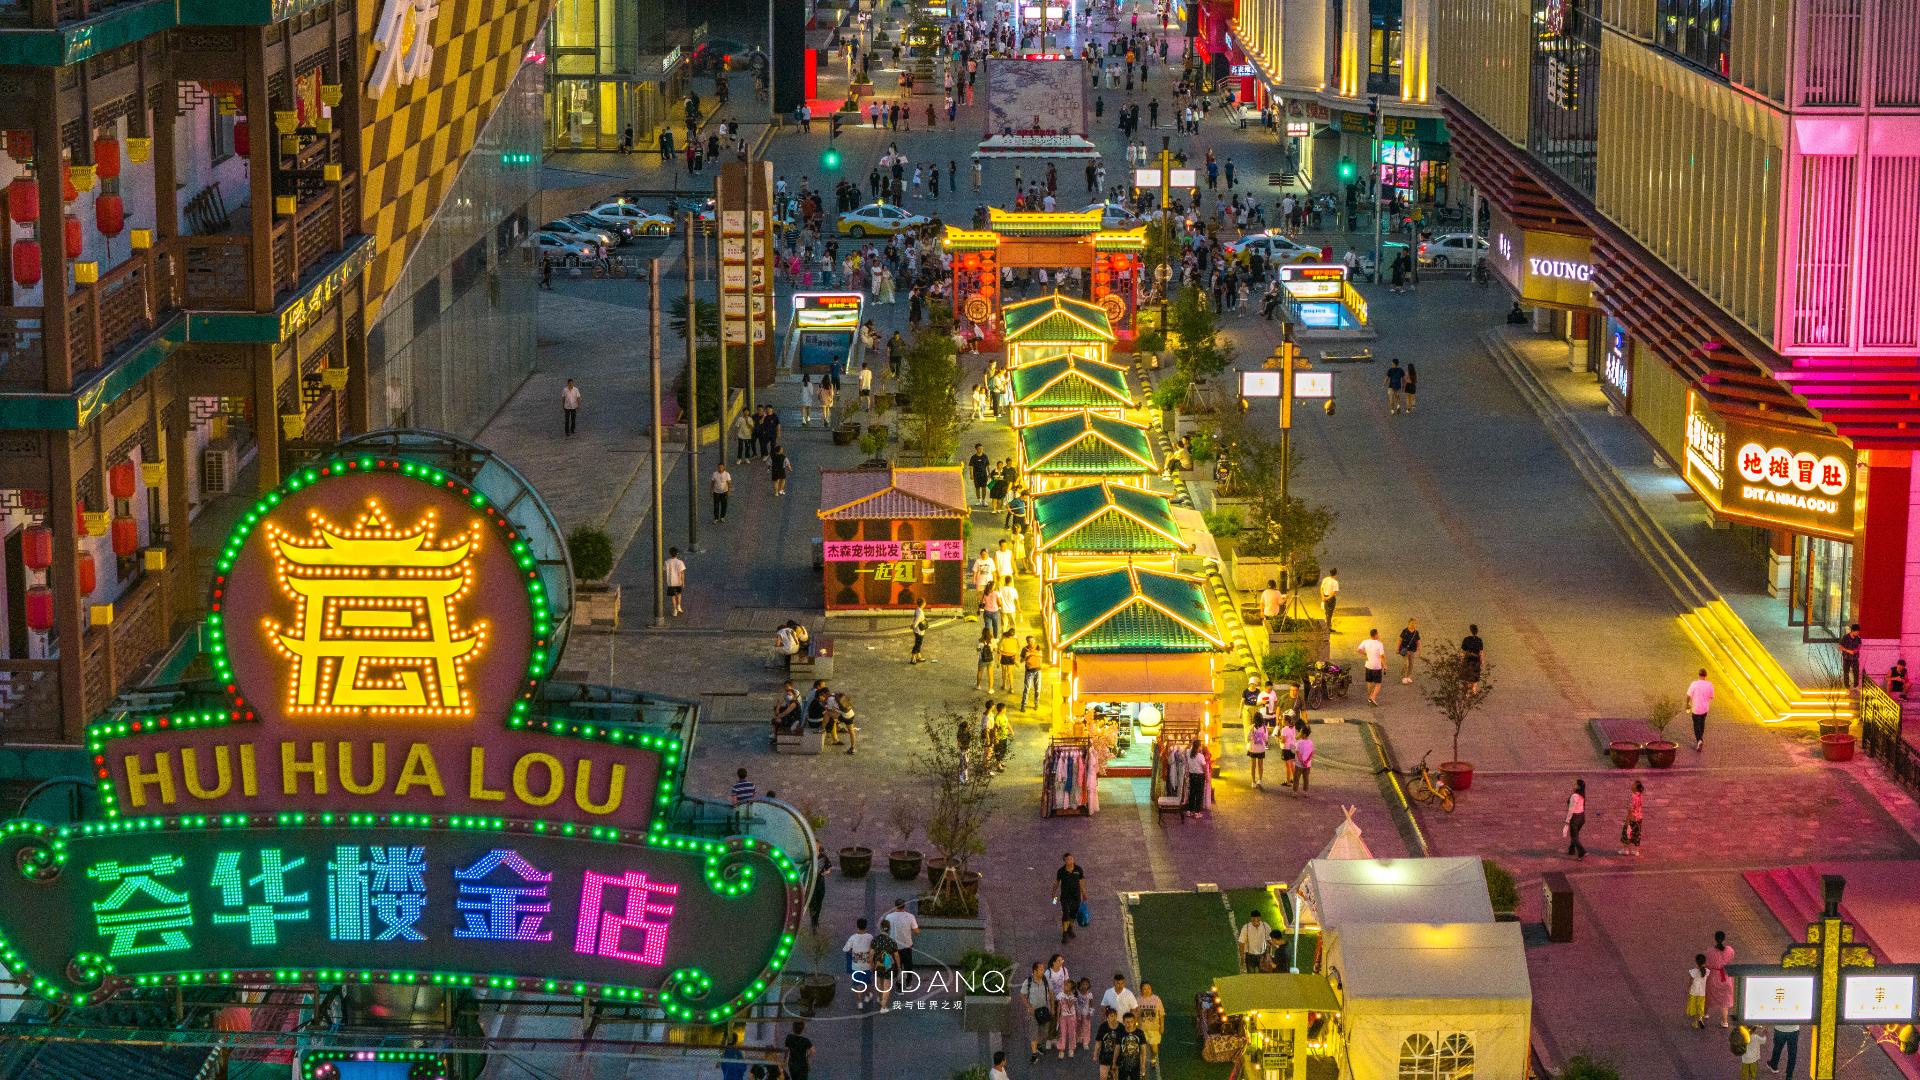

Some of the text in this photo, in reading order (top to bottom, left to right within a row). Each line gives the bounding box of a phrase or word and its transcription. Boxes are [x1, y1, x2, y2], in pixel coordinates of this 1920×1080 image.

[1743, 452, 1843, 487] 地摊冒肚
[1743, 486, 1838, 514] DITANMAODU
[827, 544, 899, 558] 杰森宠物批发
[854, 561, 918, 583] 一起红
[124, 741, 626, 817] HUI HUA LOU
[87, 845, 679, 968] 荟华楼金店
